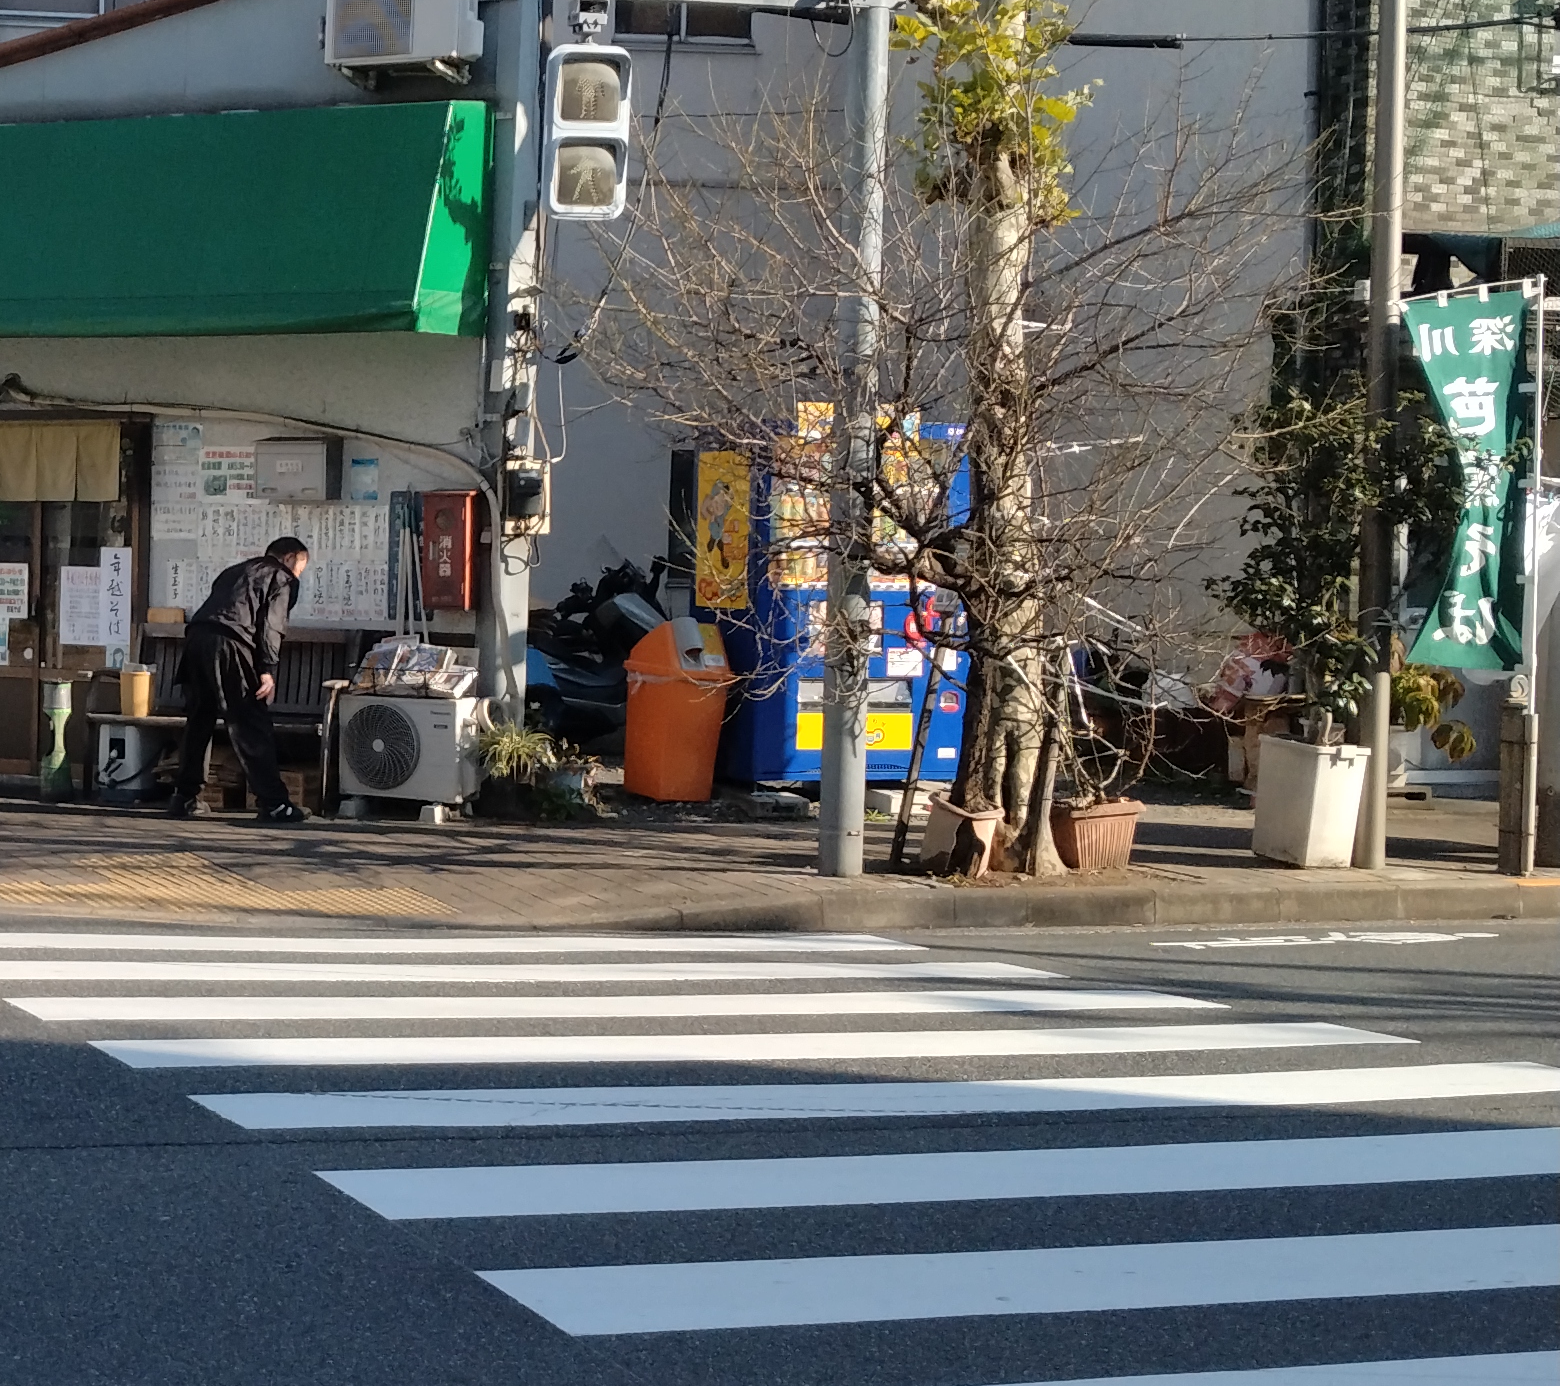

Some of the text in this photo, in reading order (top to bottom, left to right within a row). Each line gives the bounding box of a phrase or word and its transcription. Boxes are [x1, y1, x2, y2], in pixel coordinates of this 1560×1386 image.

[438, 535, 453, 577] 消火器
[106, 553, 124, 635] 年越そば
[171, 562, 180, 599] 生玉子
